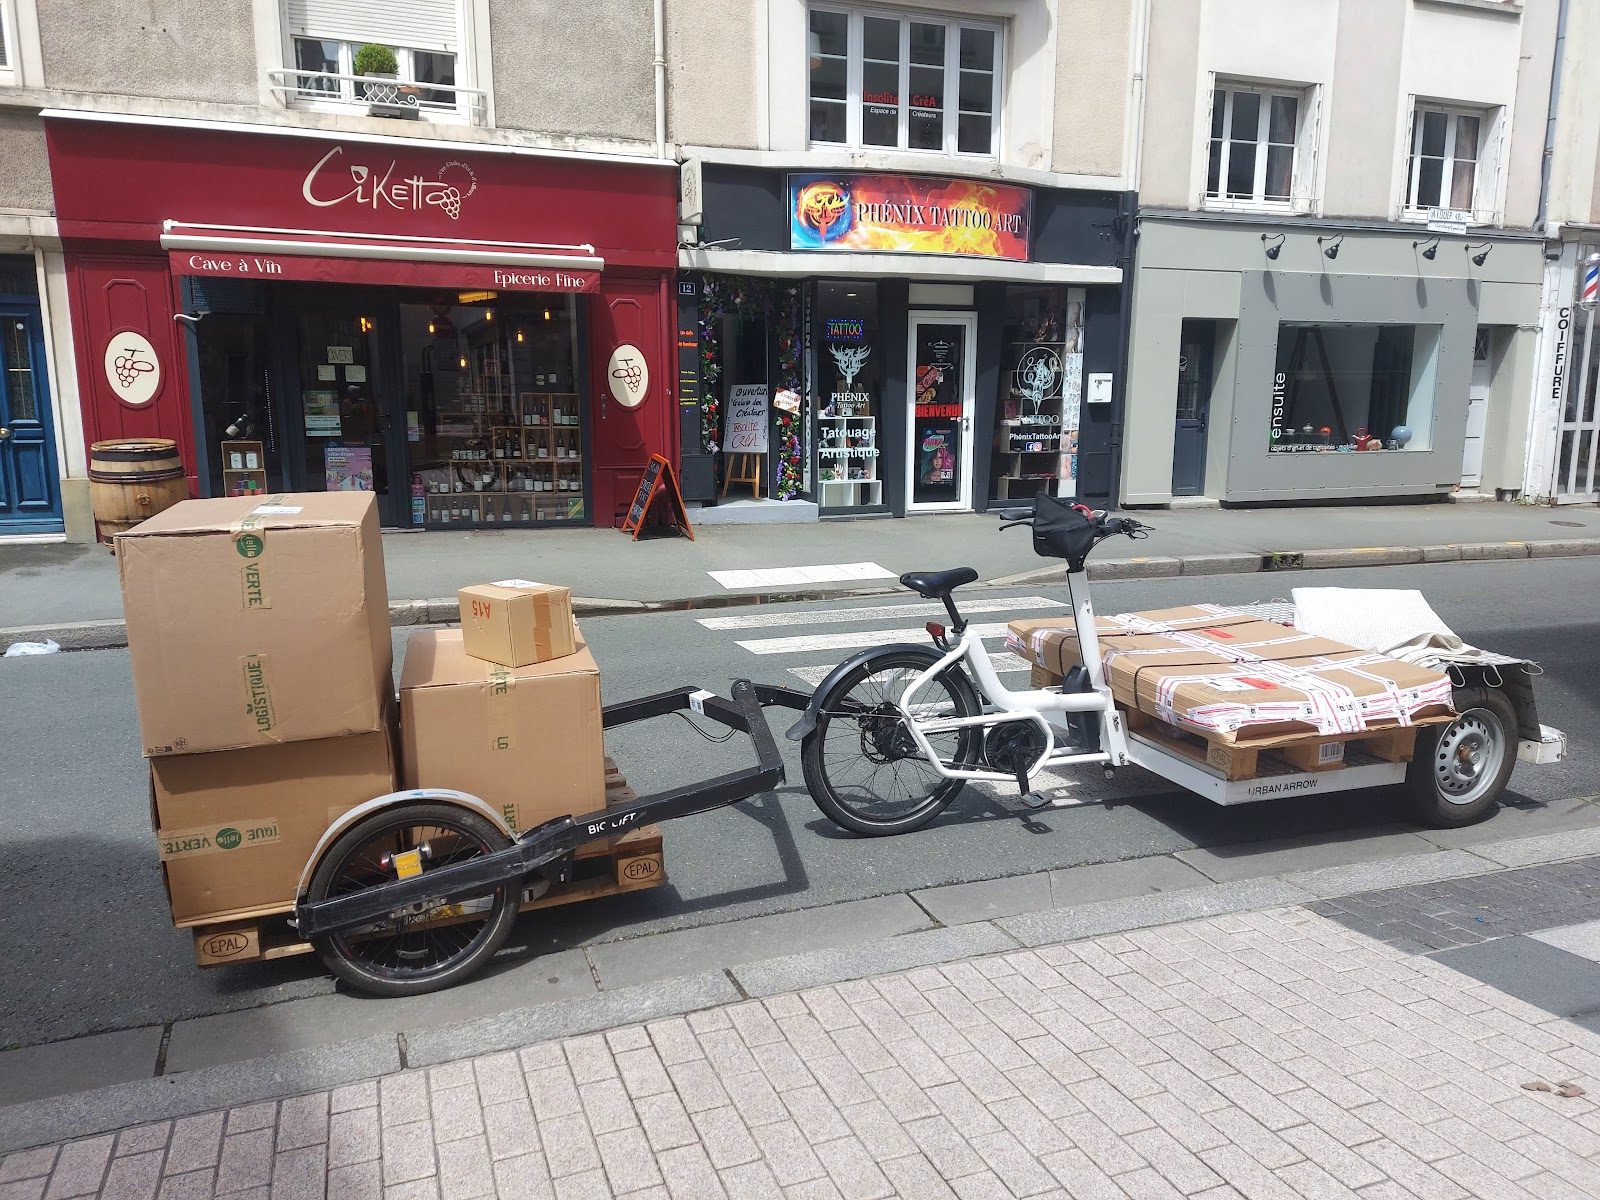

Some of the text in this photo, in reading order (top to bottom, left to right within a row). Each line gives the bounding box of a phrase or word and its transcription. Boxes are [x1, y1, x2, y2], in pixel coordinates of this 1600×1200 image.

[929, 206, 992, 230] TATTOO
[994, 213, 1022, 233] ART
[189, 255, 282, 273] Cave à Vin
[494, 270, 585, 288] Epicerie Fine
[682, 284, 692, 293] 12
[829, 323, 861, 335] TATTOO
[1552, 307, 1569, 399] COIFFURE
[831, 391, 870, 402] PHÉNIX
[1272, 372, 1286, 439] ensuite
[821, 427, 876, 440] Tatouage
[821, 447, 880, 460] Artistique
[472, 600, 490, 619] A15
[248, 659, 272, 732] LOGISTIQUE
[1282, 779, 1318, 792] ARROW
[630, 861, 653, 876] EPAL
[210, 936, 242, 954] EPAL
